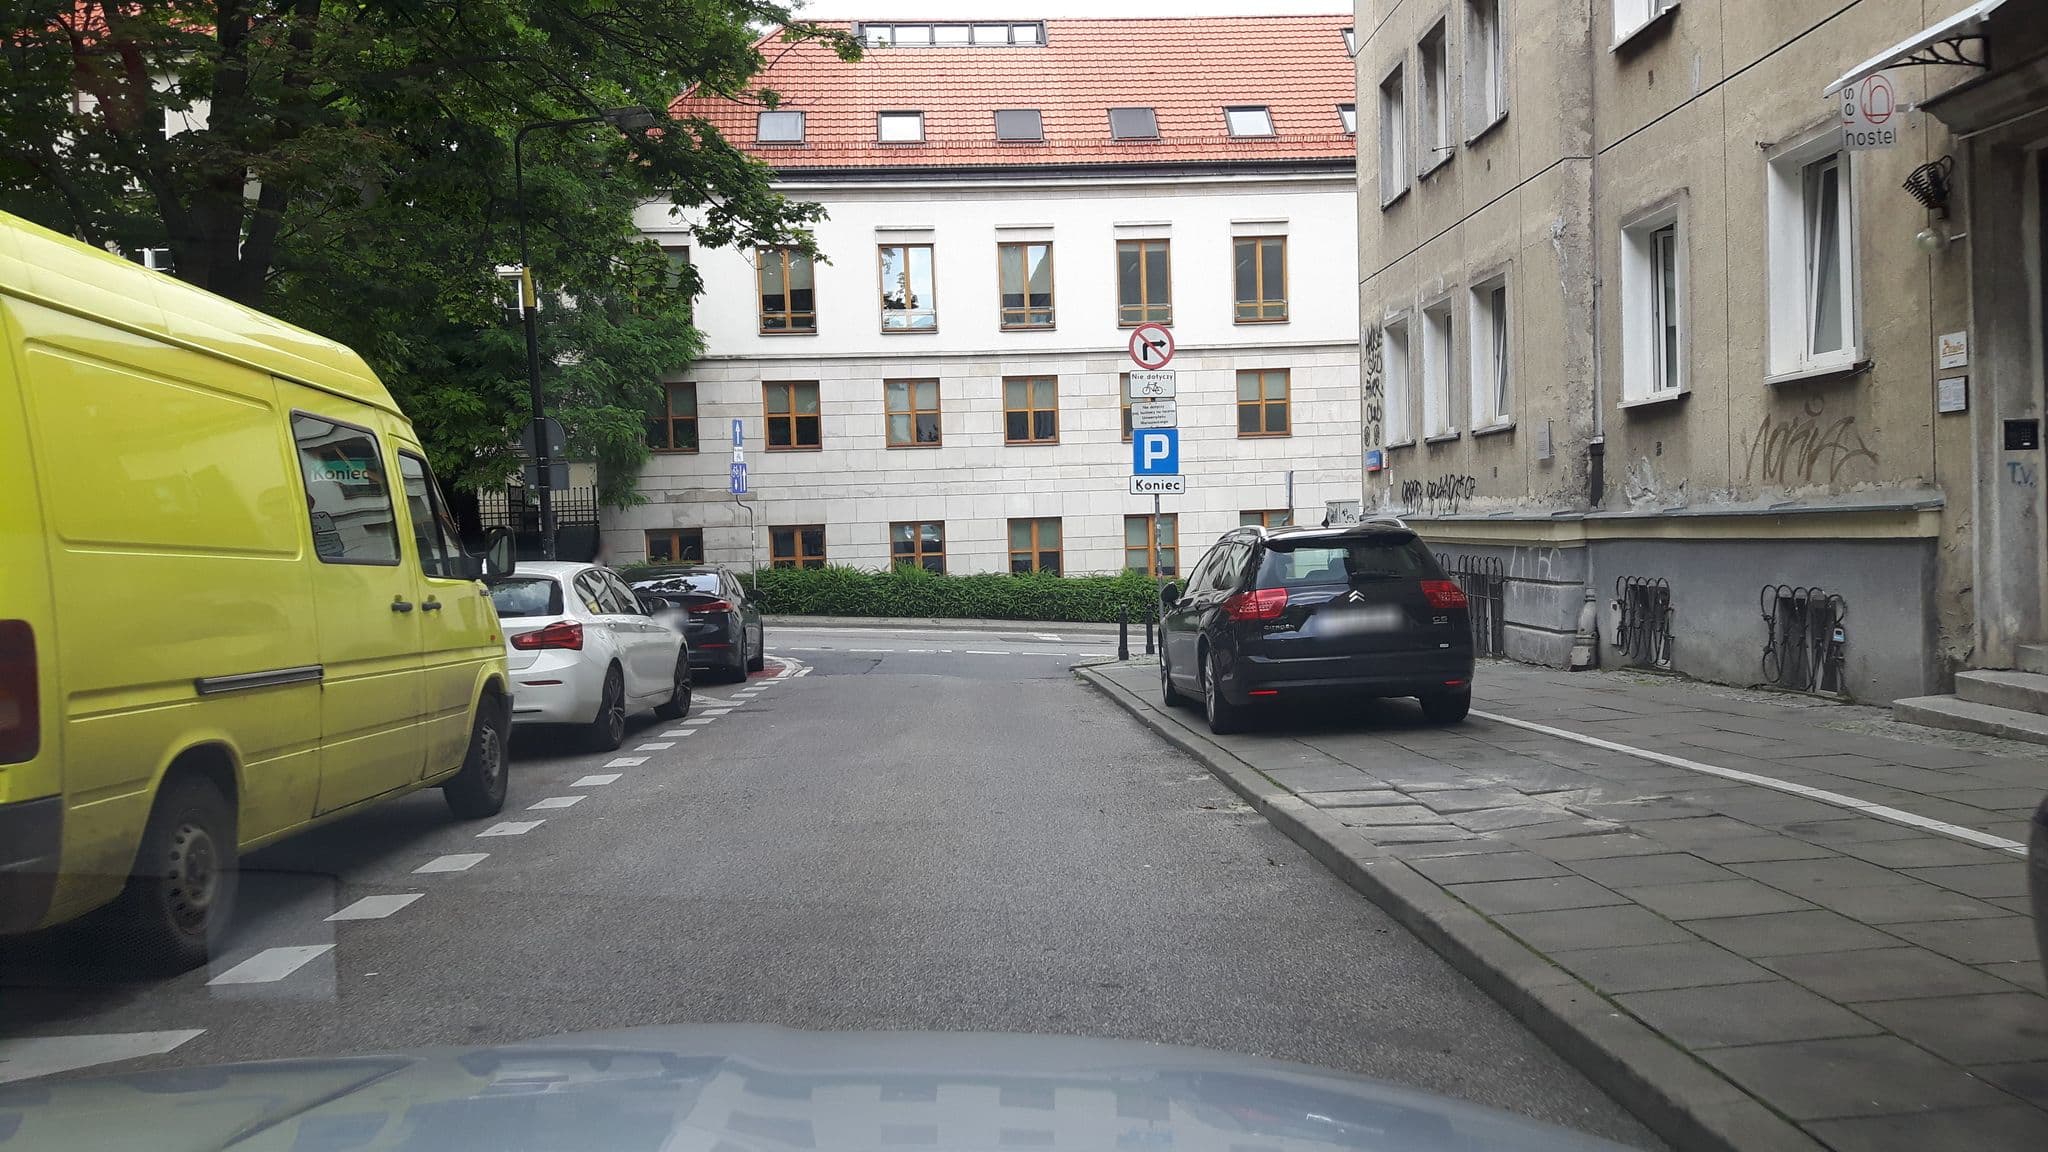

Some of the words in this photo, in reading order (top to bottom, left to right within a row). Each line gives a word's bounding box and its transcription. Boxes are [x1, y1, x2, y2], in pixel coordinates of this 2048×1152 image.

[1845, 127, 1897, 146] hostel
[1144, 434, 1169, 470] P
[1135, 479, 1180, 491] Koniec
